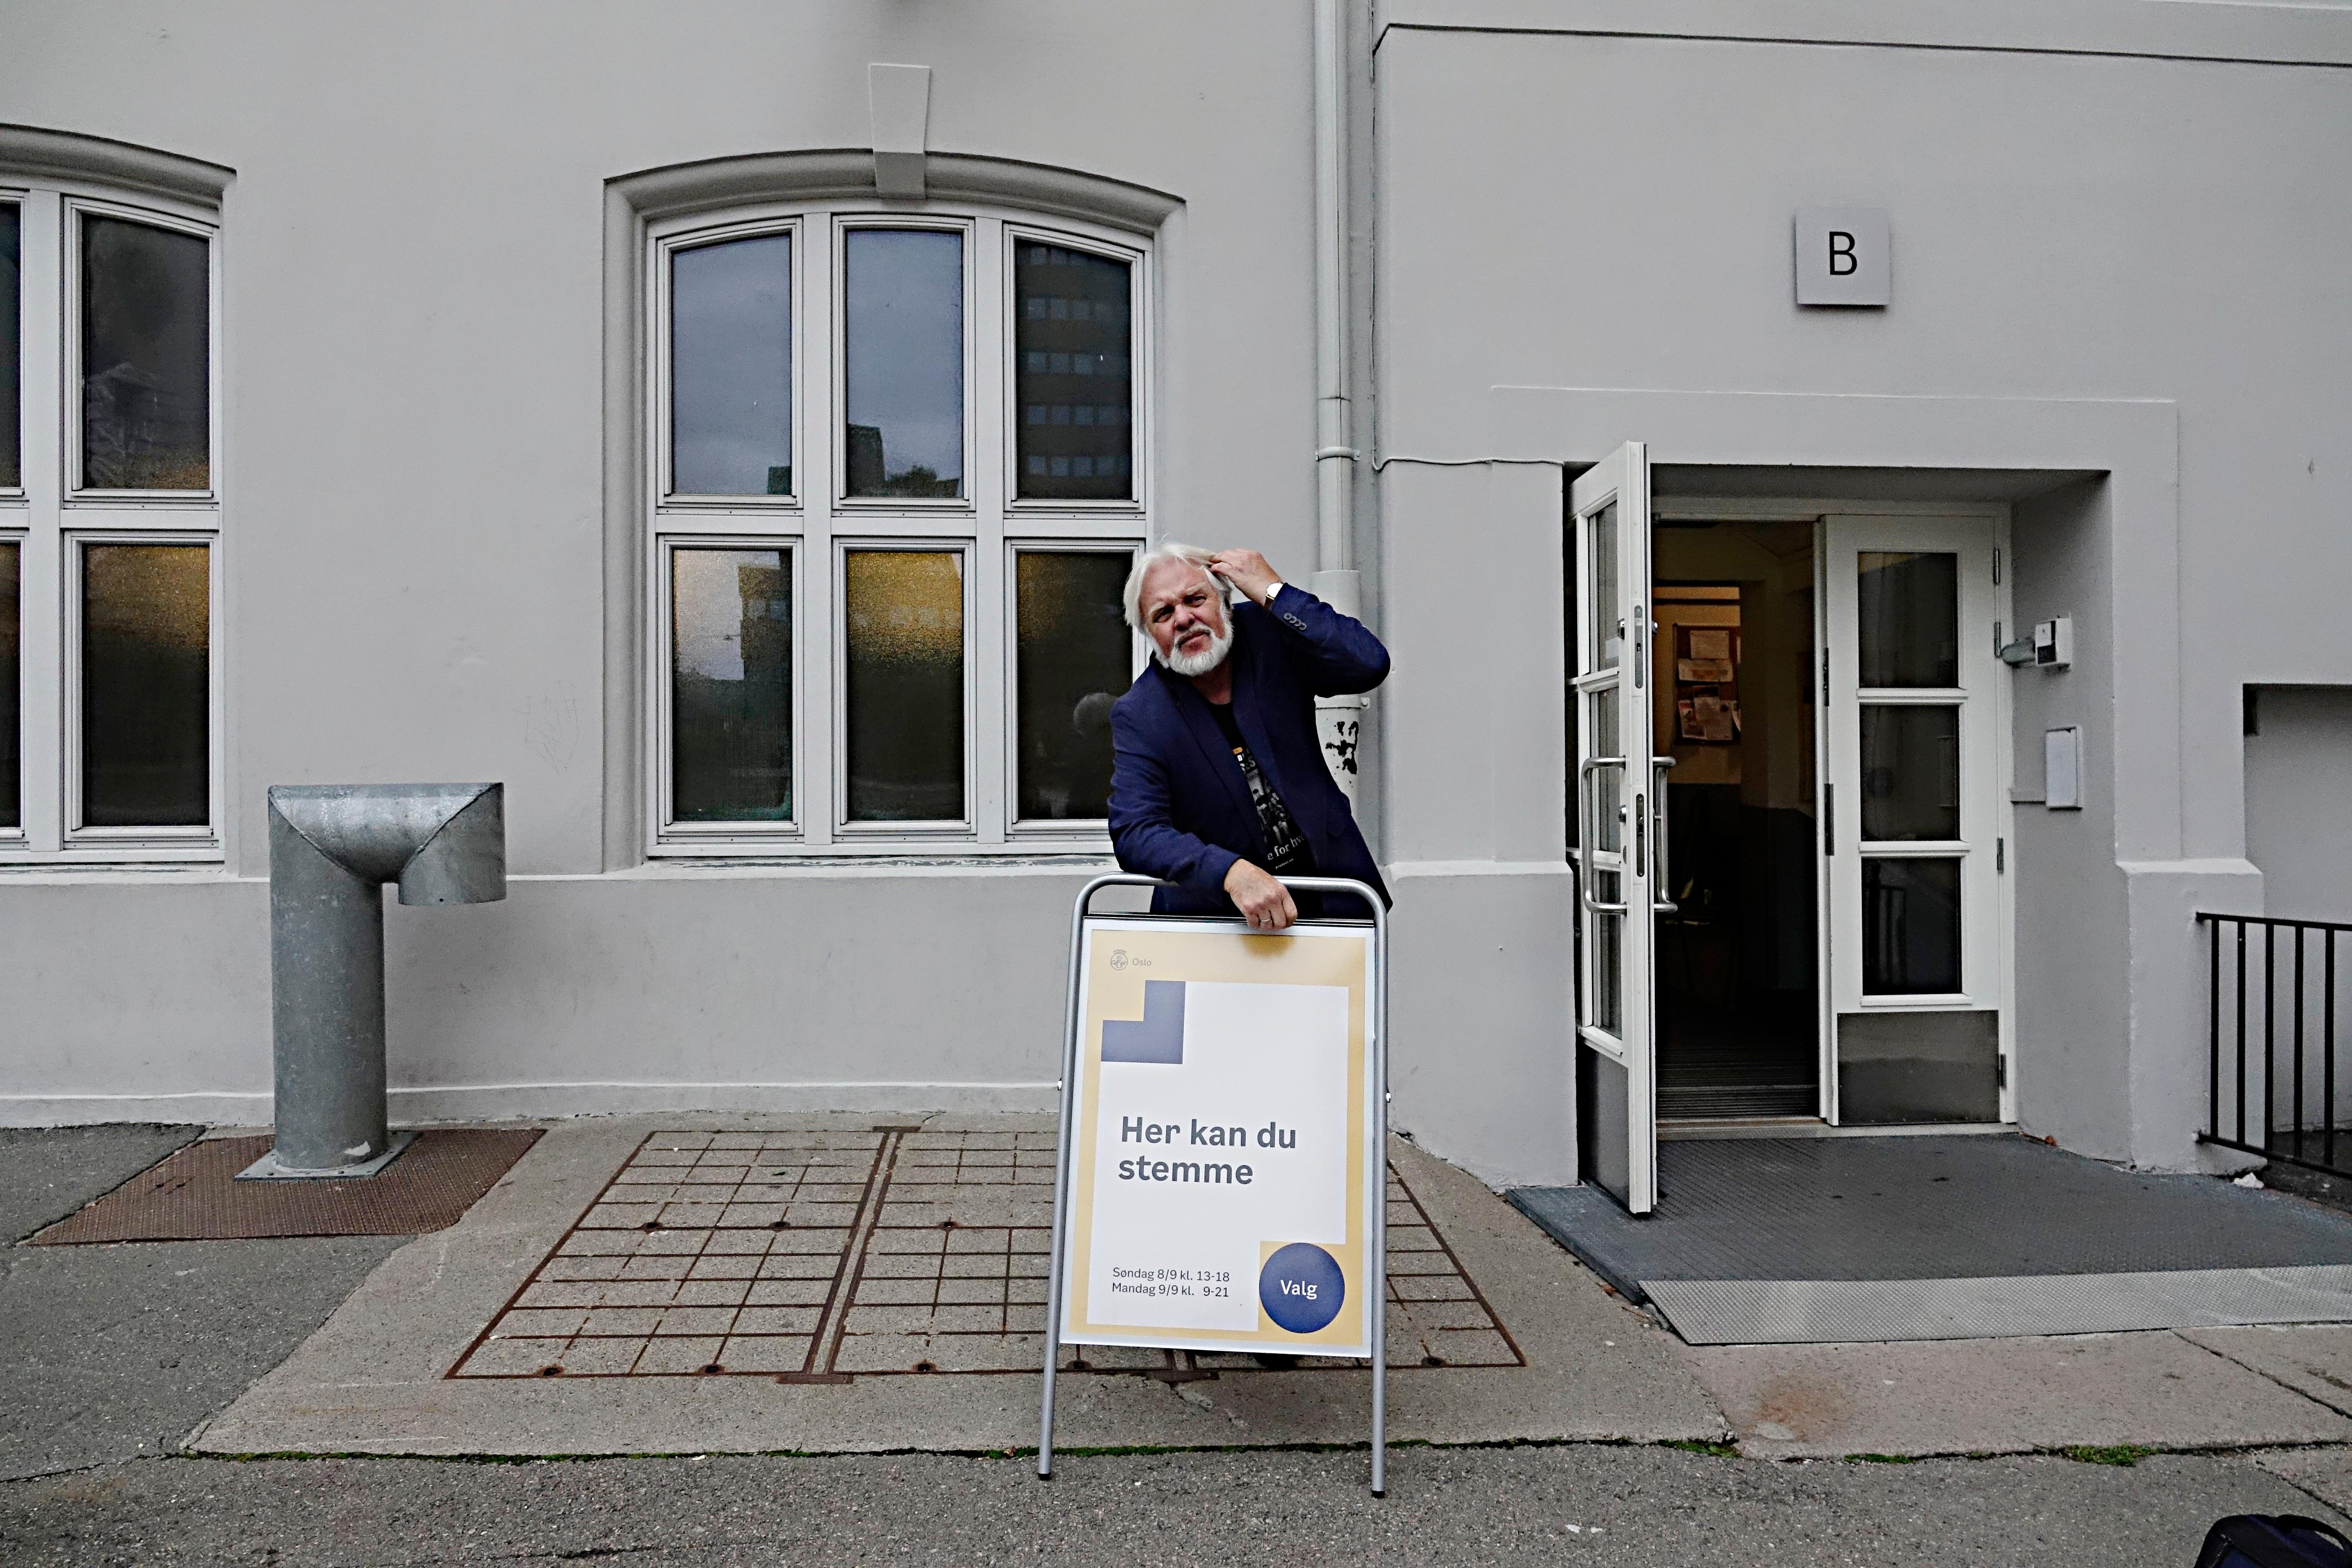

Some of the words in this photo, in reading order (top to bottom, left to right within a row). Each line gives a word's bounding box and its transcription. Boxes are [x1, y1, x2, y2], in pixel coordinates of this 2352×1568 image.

[1829, 231, 1858, 276] B
[1274, 844, 1290, 857] for
[1132, 958, 1152, 966] Oslo
[1121, 1116, 1181, 1144] Her
[1190, 1118, 1246, 1147] kan
[1257, 1121, 1296, 1148] du
[1118, 1155, 1253, 1185] stemme
[1113, 1267, 1155, 1281] Søndag
[1157, 1269, 1177, 1281] 8/9
[1180, 1270, 1193, 1281] kl.
[1197, 1271, 1230, 1282] 13-18
[1112, 1282, 1156, 1297] Mandag
[1158, 1284, 1179, 1296] 9/9
[1182, 1285, 1194, 1297] kl.
[1203, 1286, 1229, 1297] 9-21
[1280, 1280, 1318, 1300] Valg
